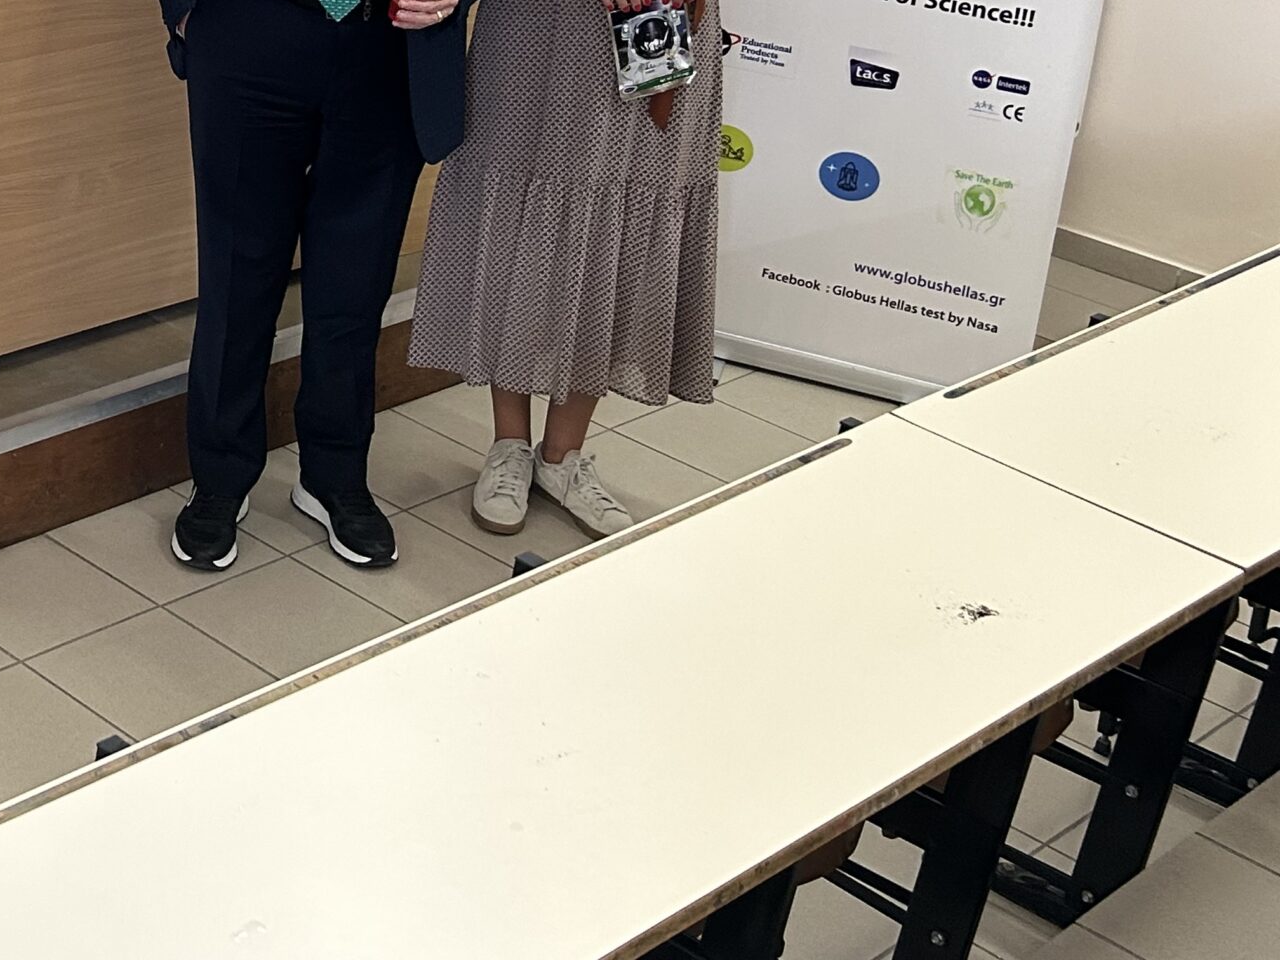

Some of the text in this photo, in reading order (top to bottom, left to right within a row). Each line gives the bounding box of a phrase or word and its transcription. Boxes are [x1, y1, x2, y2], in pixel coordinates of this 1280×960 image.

[741, 45, 778, 59] Products
[742, 37, 792, 53] Educational
[998, 79, 1028, 91] Intertek
[976, 173, 991, 185] The
[854, 263, 1006, 307] www.globushellas.gr
[761, 268, 821, 291] Facebook
[832, 285, 876, 304] Globus
[879, 296, 918, 314] Hellas
[921, 306, 945, 321] test
[947, 312, 964, 326] by
[966, 316, 998, 333] Nasa
